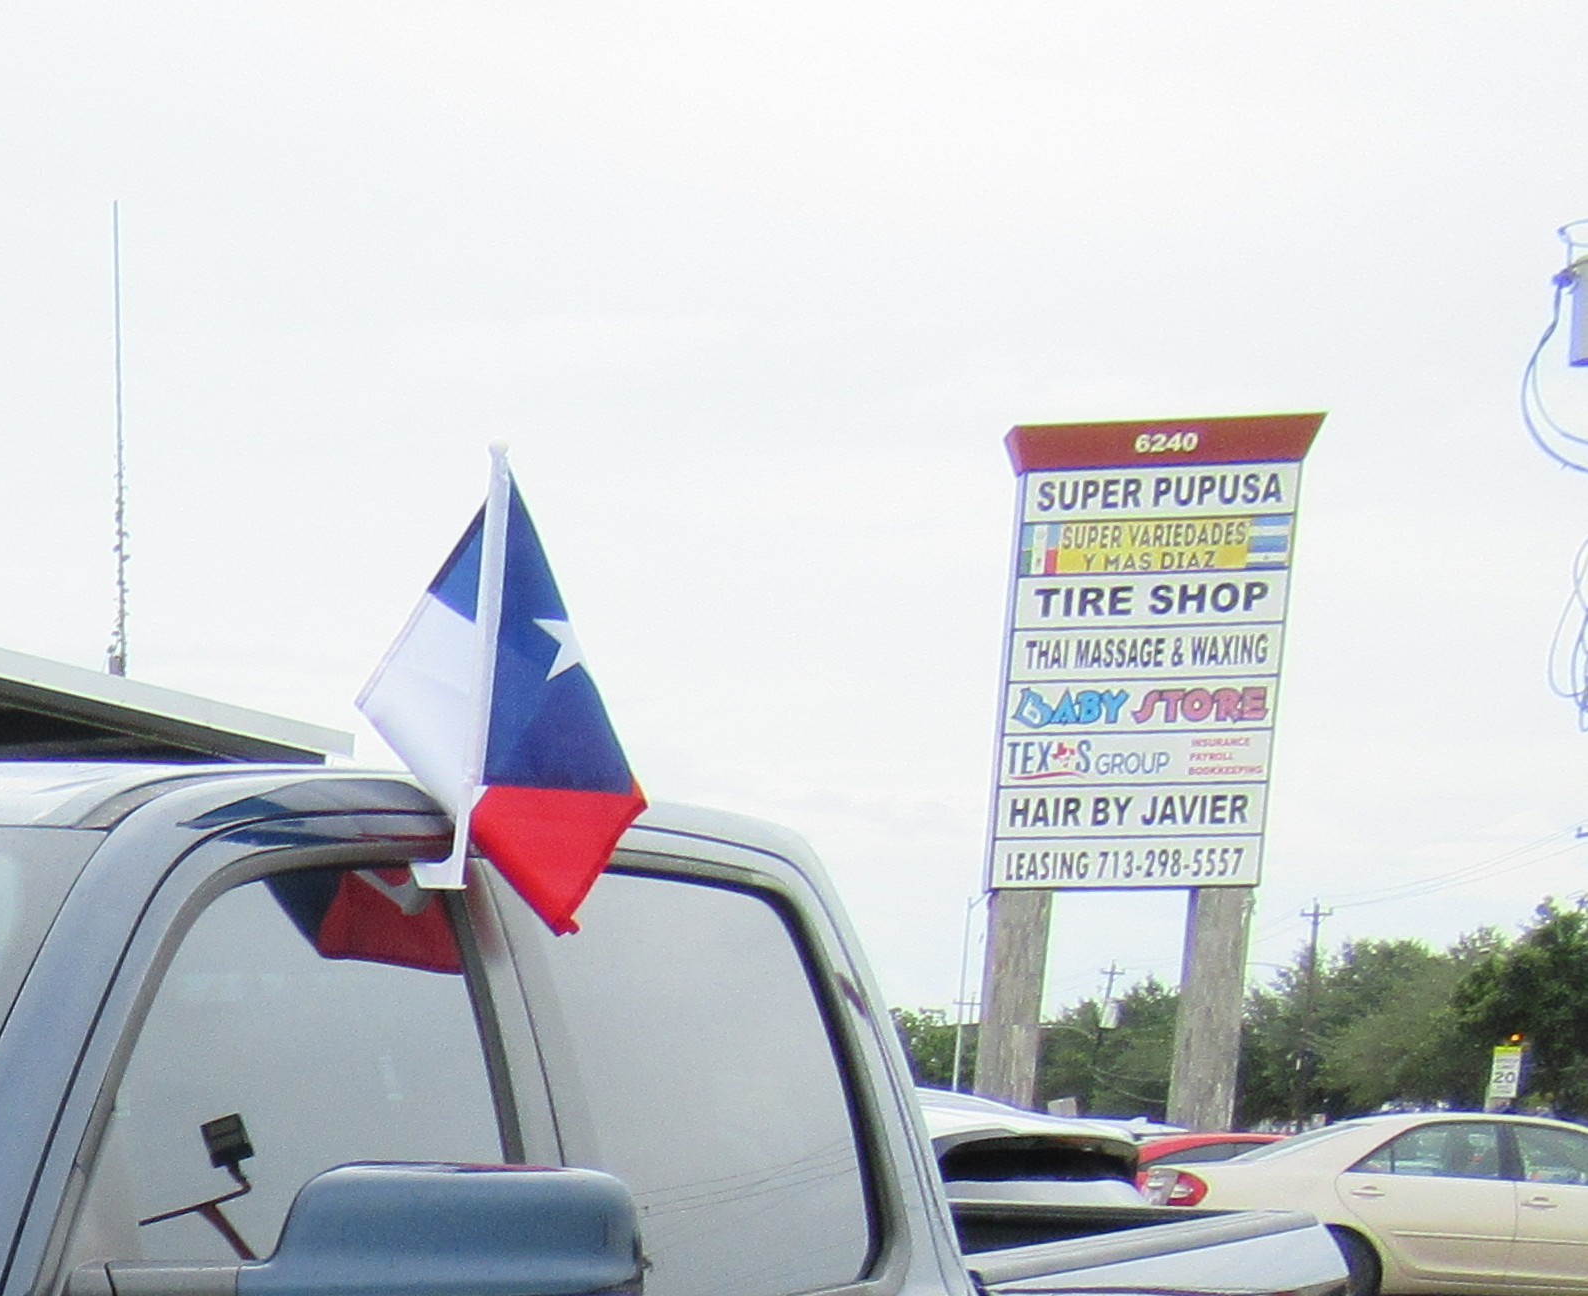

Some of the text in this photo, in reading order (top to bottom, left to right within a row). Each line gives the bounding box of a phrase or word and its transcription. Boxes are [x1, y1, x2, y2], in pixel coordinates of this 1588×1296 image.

[1133, 432, 1199, 454] 6240
[1036, 473, 1284, 512] SUPER PUPUSA
[1061, 519, 1248, 550] SUPER VARIEDADES
[1083, 550, 1216, 571] Y MAS DIAZ
[1034, 581, 1269, 618] TIRE SHOP
[1025, 633, 1269, 671] THAI MASSAGE & WAXING
[1011, 686, 1270, 729] BABY STORE
[1095, 750, 1171, 776] GROUP
[1008, 793, 1249, 828] HAIR BY JAVIER
[1005, 846, 1245, 882] LEASING 713-298-5557
[1492, 1071, 1516, 1084] 20
